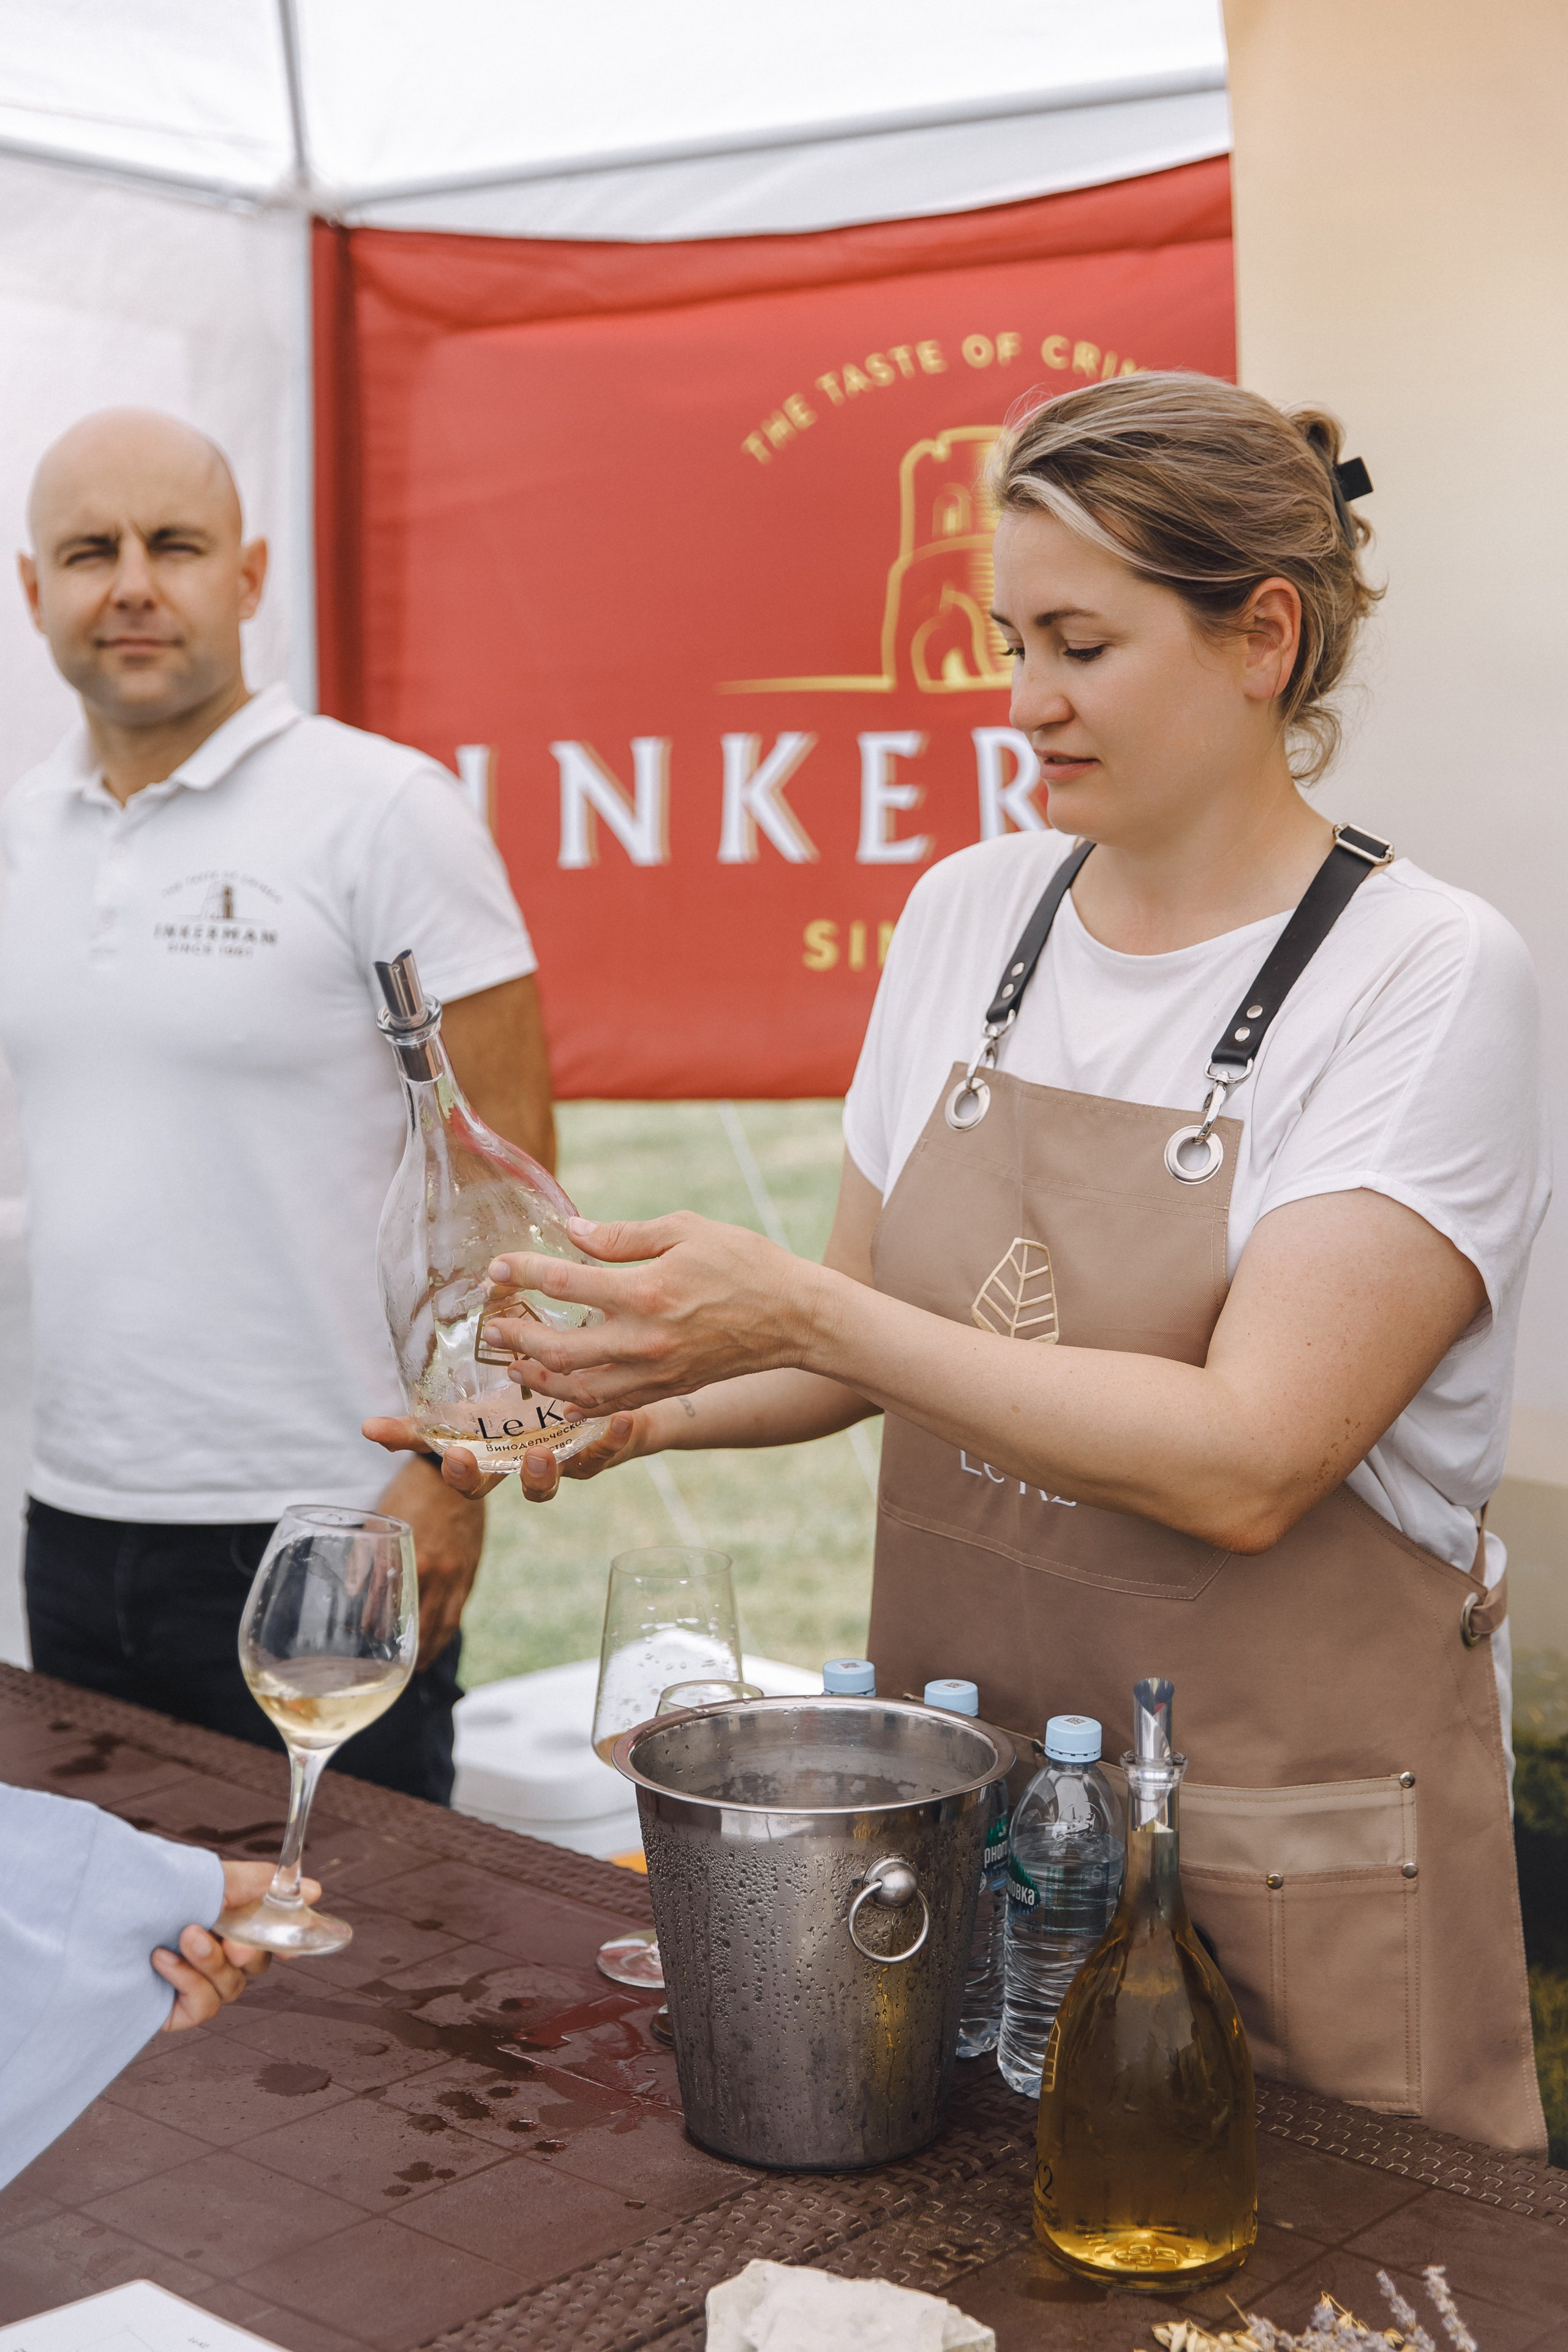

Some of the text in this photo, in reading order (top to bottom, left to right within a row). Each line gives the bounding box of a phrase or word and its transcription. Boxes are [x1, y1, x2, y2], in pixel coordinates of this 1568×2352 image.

[741, 391, 817, 466] THE
[815, 339, 948, 406] TASTE
[962, 331, 1022, 369] OF
[153, 921, 278, 946] INKERMAN
[477, 1399, 566, 1439] Le K
